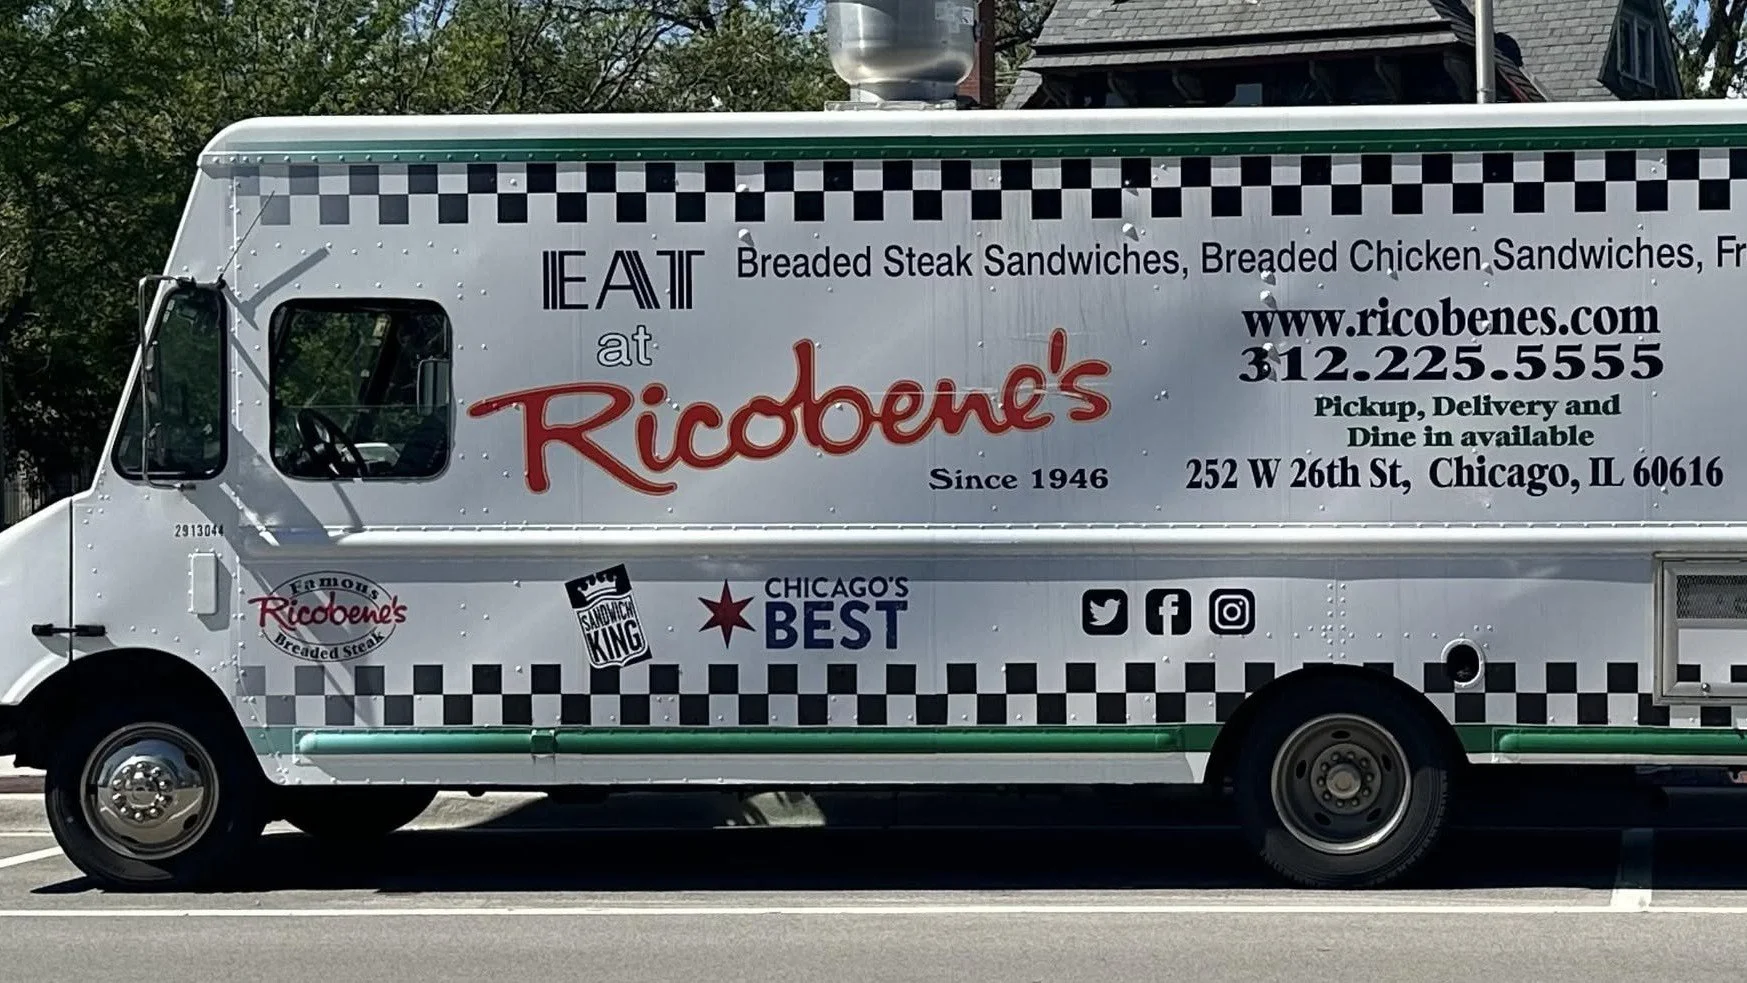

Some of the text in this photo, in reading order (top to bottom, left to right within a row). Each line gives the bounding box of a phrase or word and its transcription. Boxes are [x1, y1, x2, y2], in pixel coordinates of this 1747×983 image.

[737, 246, 872, 277] Breaded
[883, 244, 973, 277] Steak
[984, 242, 1189, 280] Sandwiches,
[1201, 240, 1338, 274] Breaded
[1350, 238, 1482, 272] Chicken
[1493, 237, 1703, 275] Sandwiches,
[542, 249, 705, 310] EAT
[1241, 296, 1661, 338] www.ricobenes.com
[596, 324, 653, 367] at
[1238, 343, 1664, 382] 312.225.5555
[466, 327, 1112, 496] Ricobene's
[1314, 394, 1622, 422] Pickup, Delivery and
[1347, 424, 1595, 448] Dine in available
[928, 468, 1109, 491] Since 1946
[1186, 454, 1724, 496] 252 W 26th St, Chicago, IL 60616
[175, 524, 224, 537] 2913044
[289, 577, 379, 600] Famous
[764, 576, 909, 598] CHICAGO'S
[247, 591, 408, 631] Ricobene's
[581, 600, 635, 630] SANDWICH
[765, 600, 908, 650] BEST
[273, 631, 386, 660] Breaded Steak
[586, 619, 643, 662] KING
